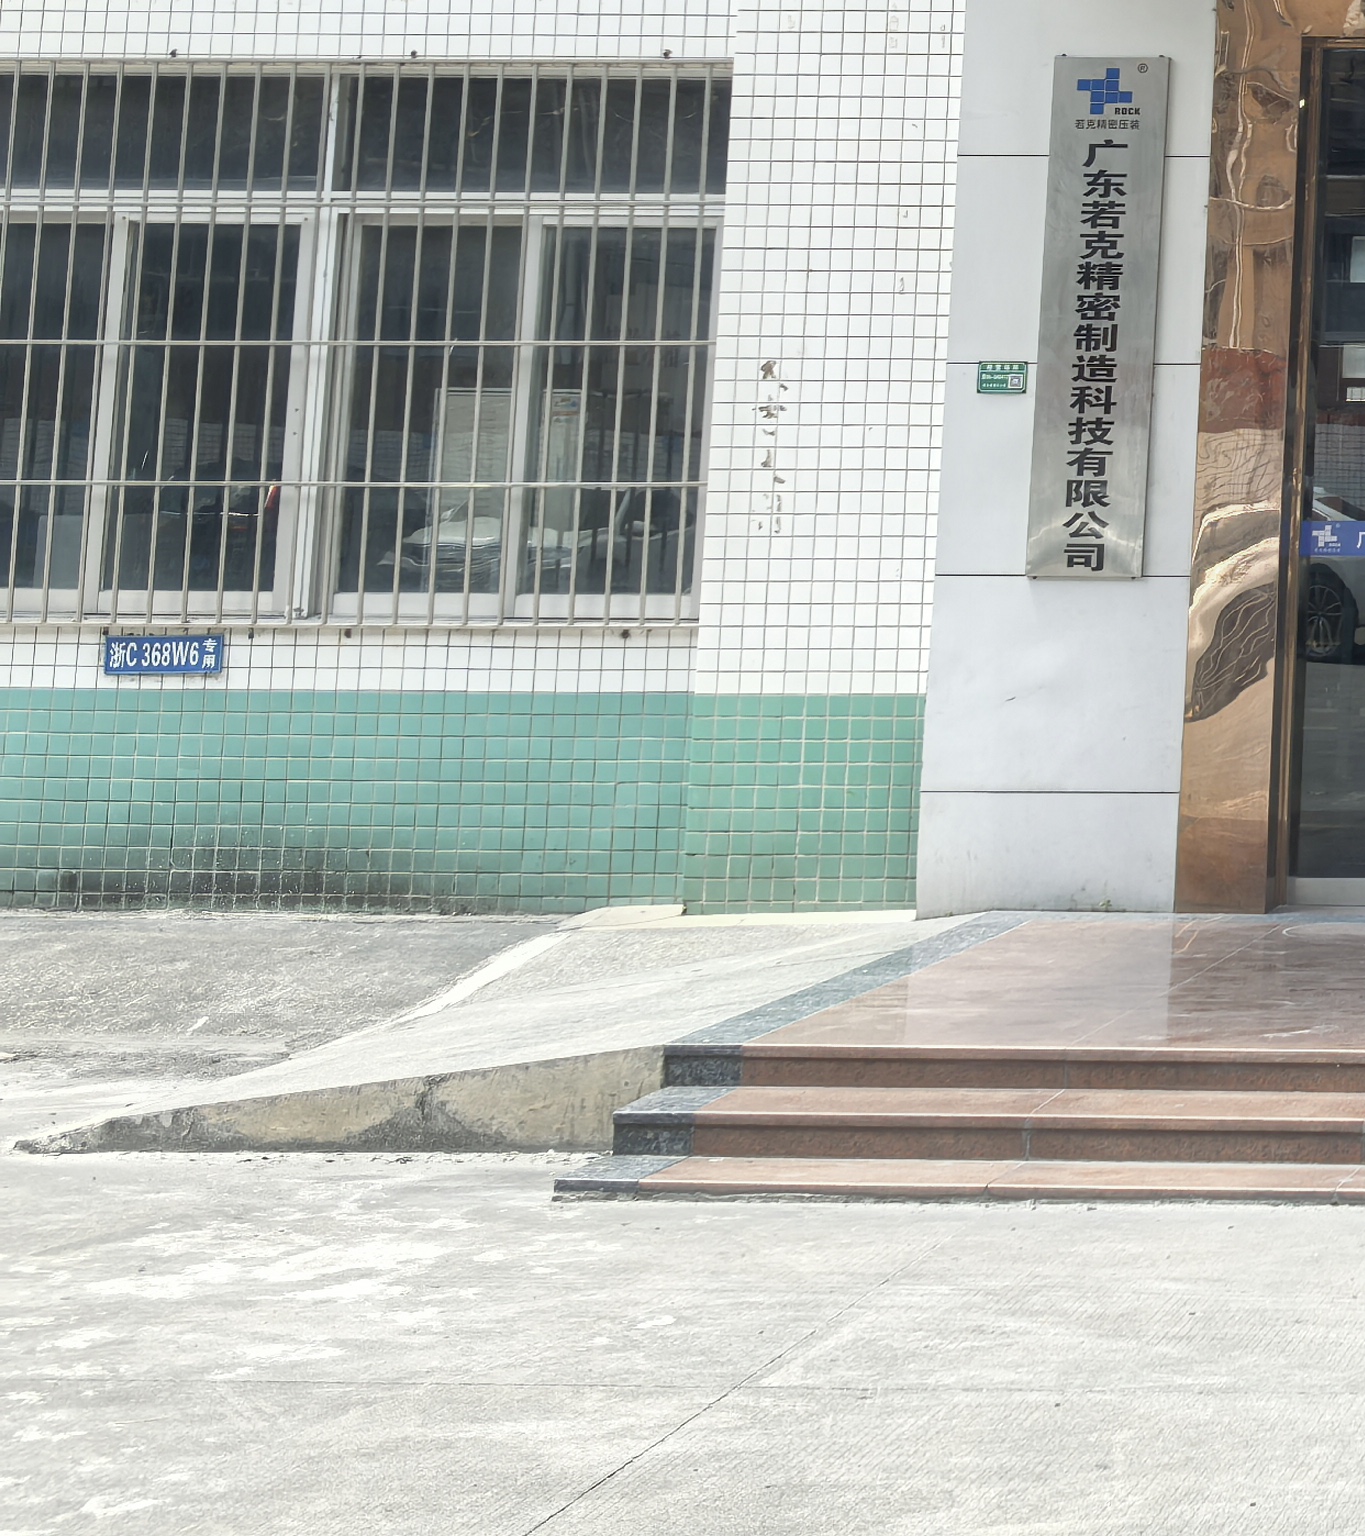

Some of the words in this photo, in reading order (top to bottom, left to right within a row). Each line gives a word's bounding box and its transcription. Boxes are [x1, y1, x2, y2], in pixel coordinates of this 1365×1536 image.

[1114, 107, 1141, 115] ROCK
[1063, 139, 1129, 572] 广东若克精密制造科技有限公司
[109, 641, 138, 669] 浙C
[141, 641, 200, 667] 368W6
[201, 638, 218, 670] 专用
